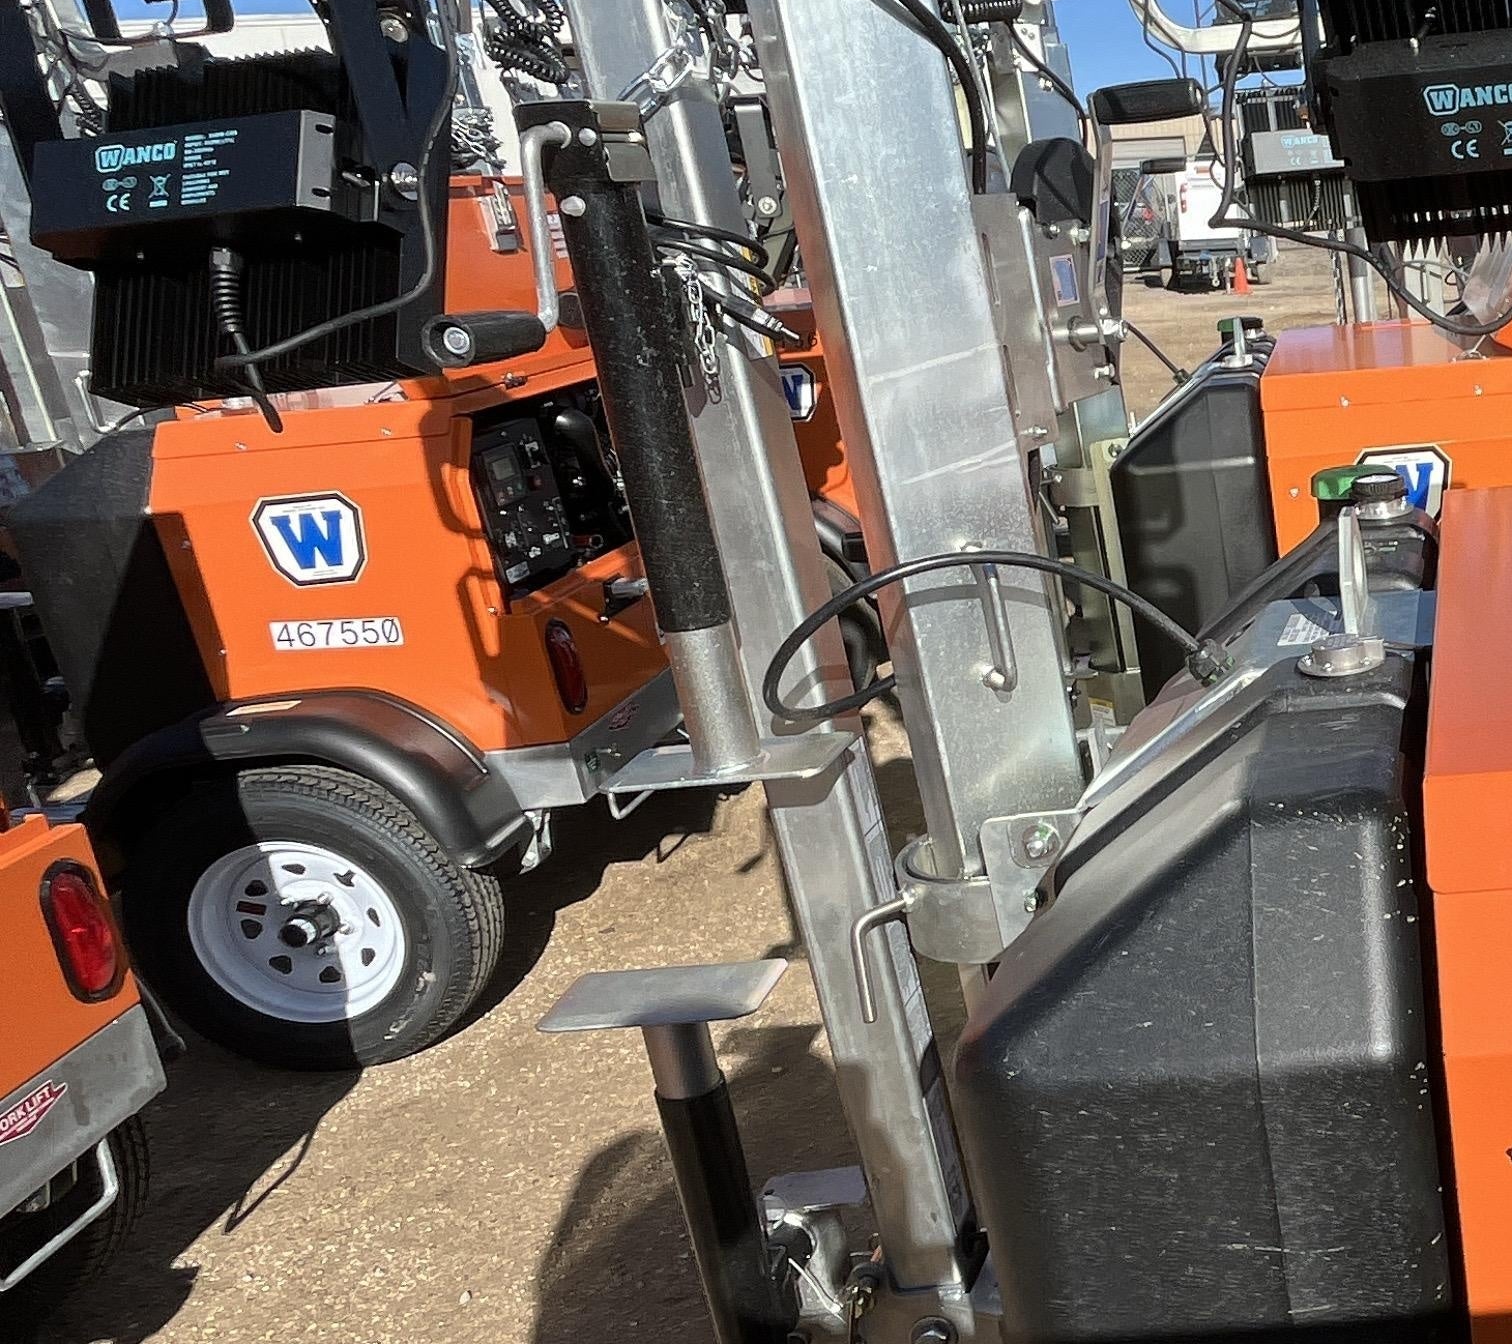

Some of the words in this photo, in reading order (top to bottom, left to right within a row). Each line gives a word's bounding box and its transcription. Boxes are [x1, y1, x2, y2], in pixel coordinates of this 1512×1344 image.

[95, 142, 176, 173] WANCO
[269, 509, 344, 570] W
[276, 618, 401, 648] 467550
